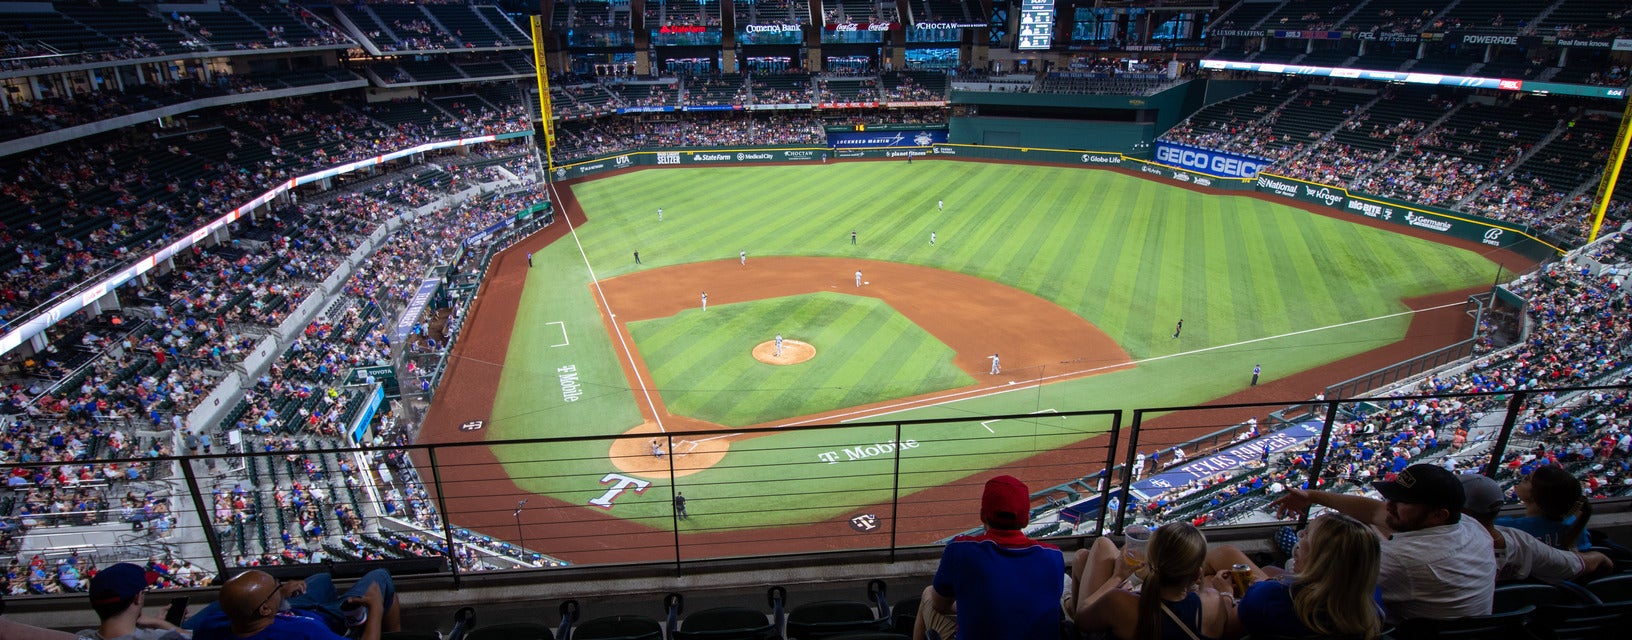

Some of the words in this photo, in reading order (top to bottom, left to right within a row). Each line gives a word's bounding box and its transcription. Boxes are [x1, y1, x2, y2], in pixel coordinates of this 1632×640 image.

[782, 24, 801, 32] Bank
[1463, 35, 1519, 45] POWERADE
[1574, 39, 1588, 47] fans
[616, 155, 630, 165] UTA
[1090, 155, 1108, 163] Globe
[1109, 156, 1121, 164] Life
[1157, 146, 1208, 169] GEICO
[1265, 179, 1298, 193] National
[1316, 188, 1343, 205] Kroger
[1348, 200, 1361, 210] BIG
[1363, 204, 1382, 214] BITE
[1419, 215, 1452, 229] Germania
[1483, 239, 1500, 247] SPORTS
[1181, 455, 1237, 478] TEXAS
